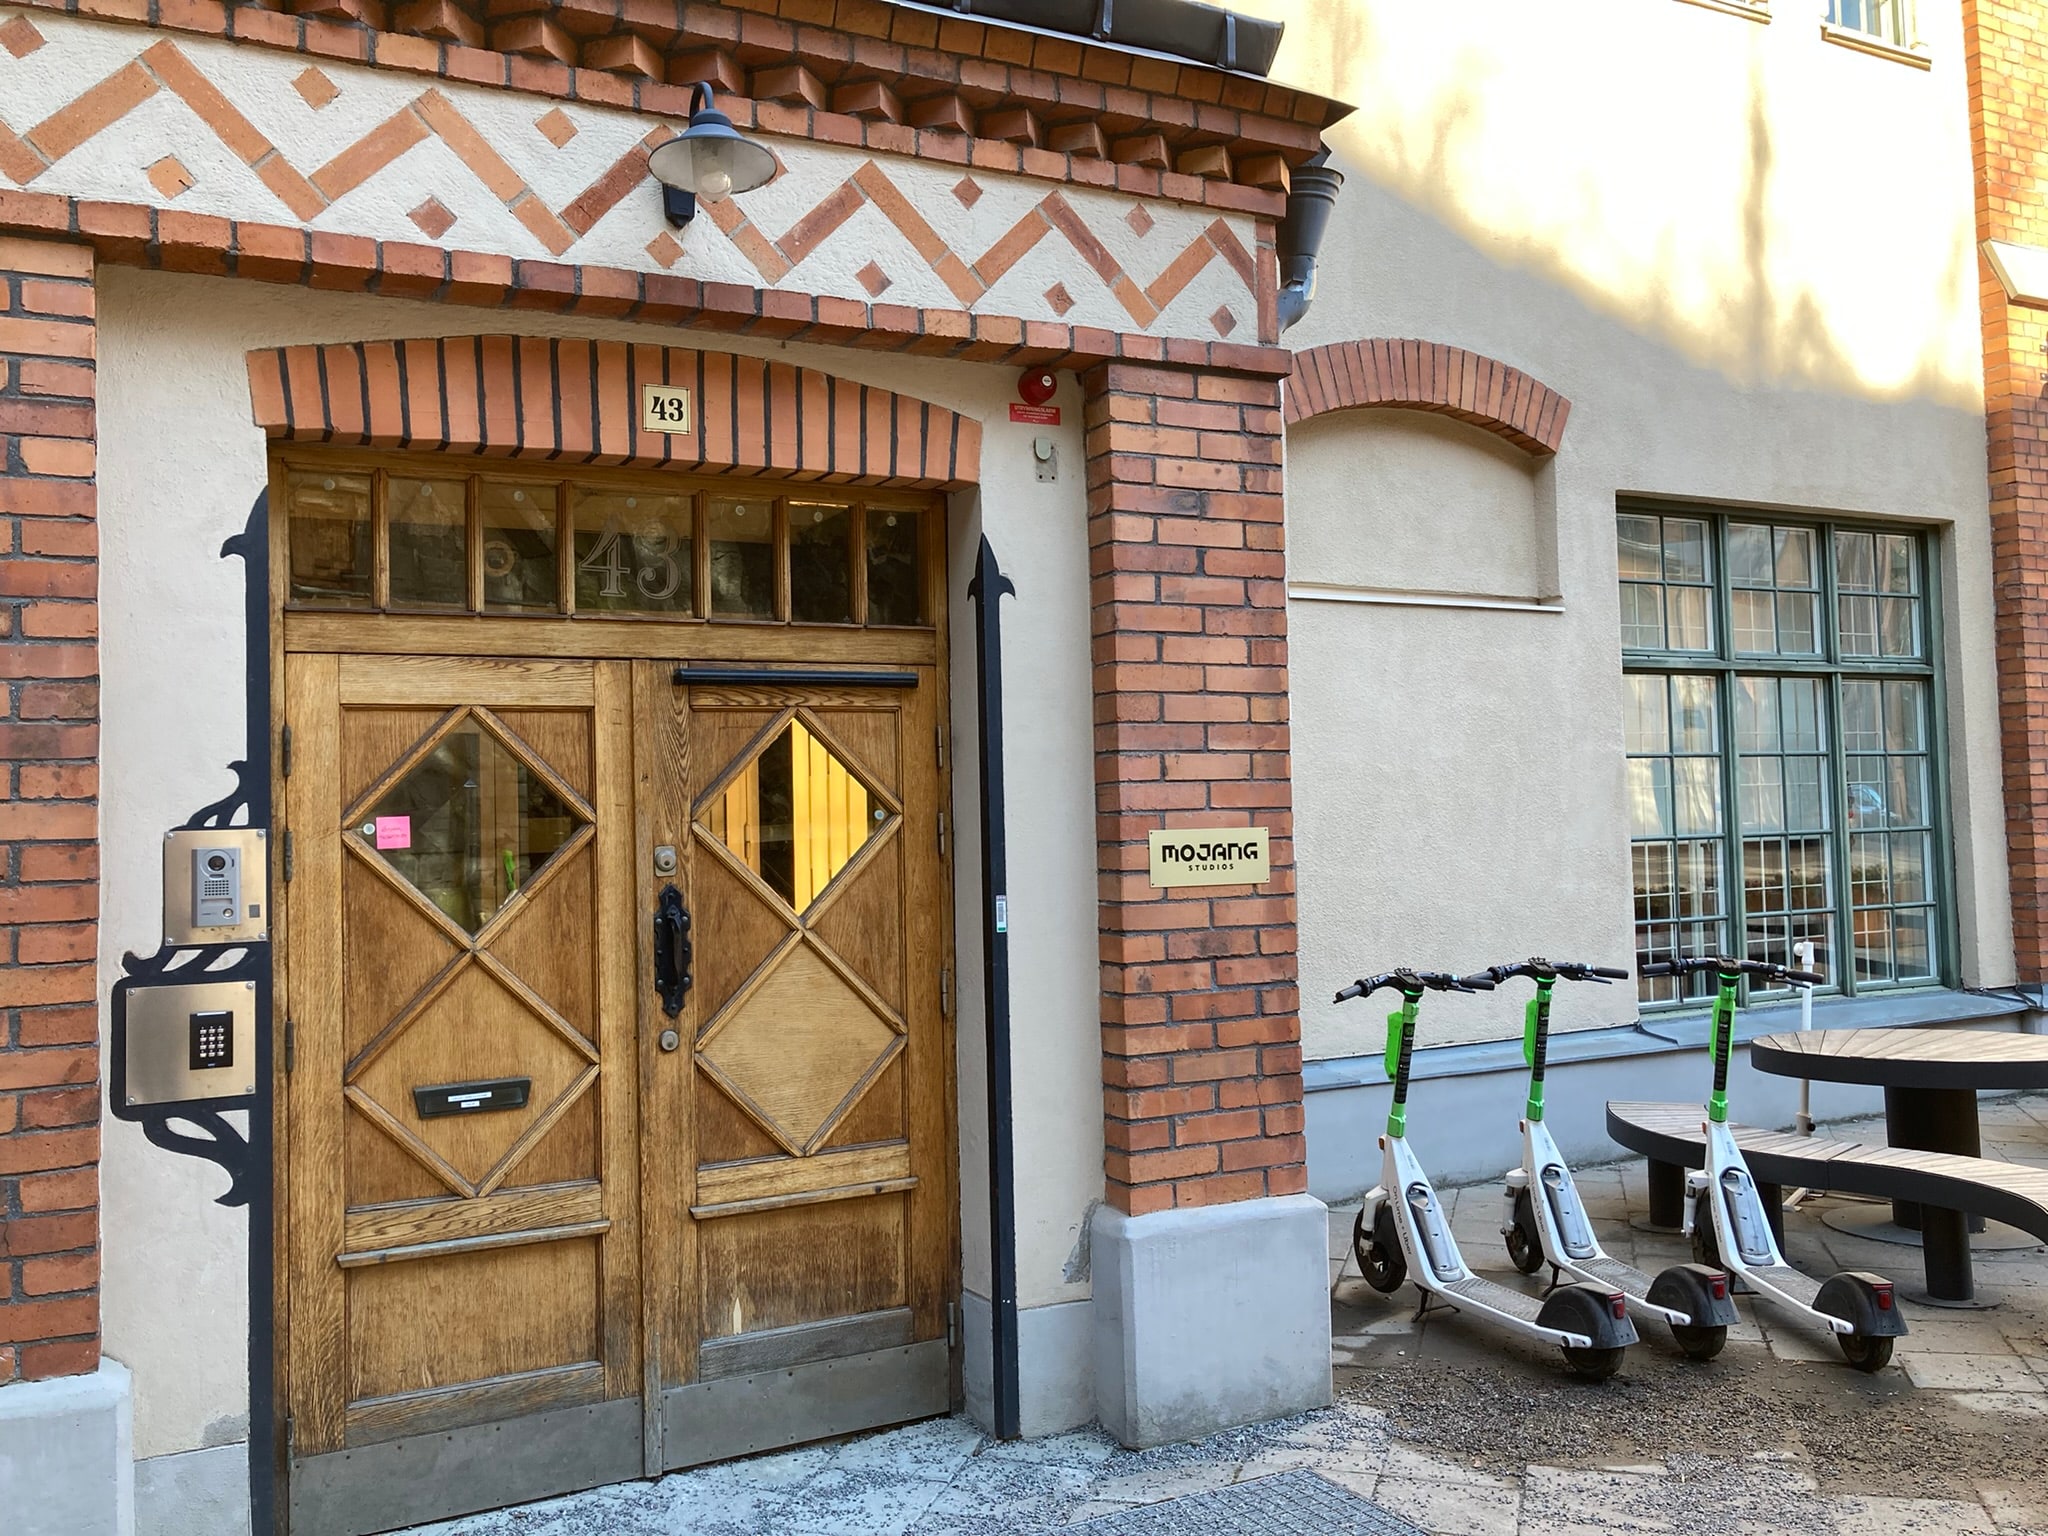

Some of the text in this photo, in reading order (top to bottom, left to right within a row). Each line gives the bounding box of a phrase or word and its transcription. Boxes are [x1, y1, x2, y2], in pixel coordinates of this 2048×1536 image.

[651, 396, 683, 422] 43
[578, 512, 682, 600] 43
[1162, 842, 1258, 862] MOJANG
[1188, 863, 1234, 872] STUDIOS
[1395, 1201, 1403, 1224] Lime
[1402, 1231, 1412, 1255] Uber
